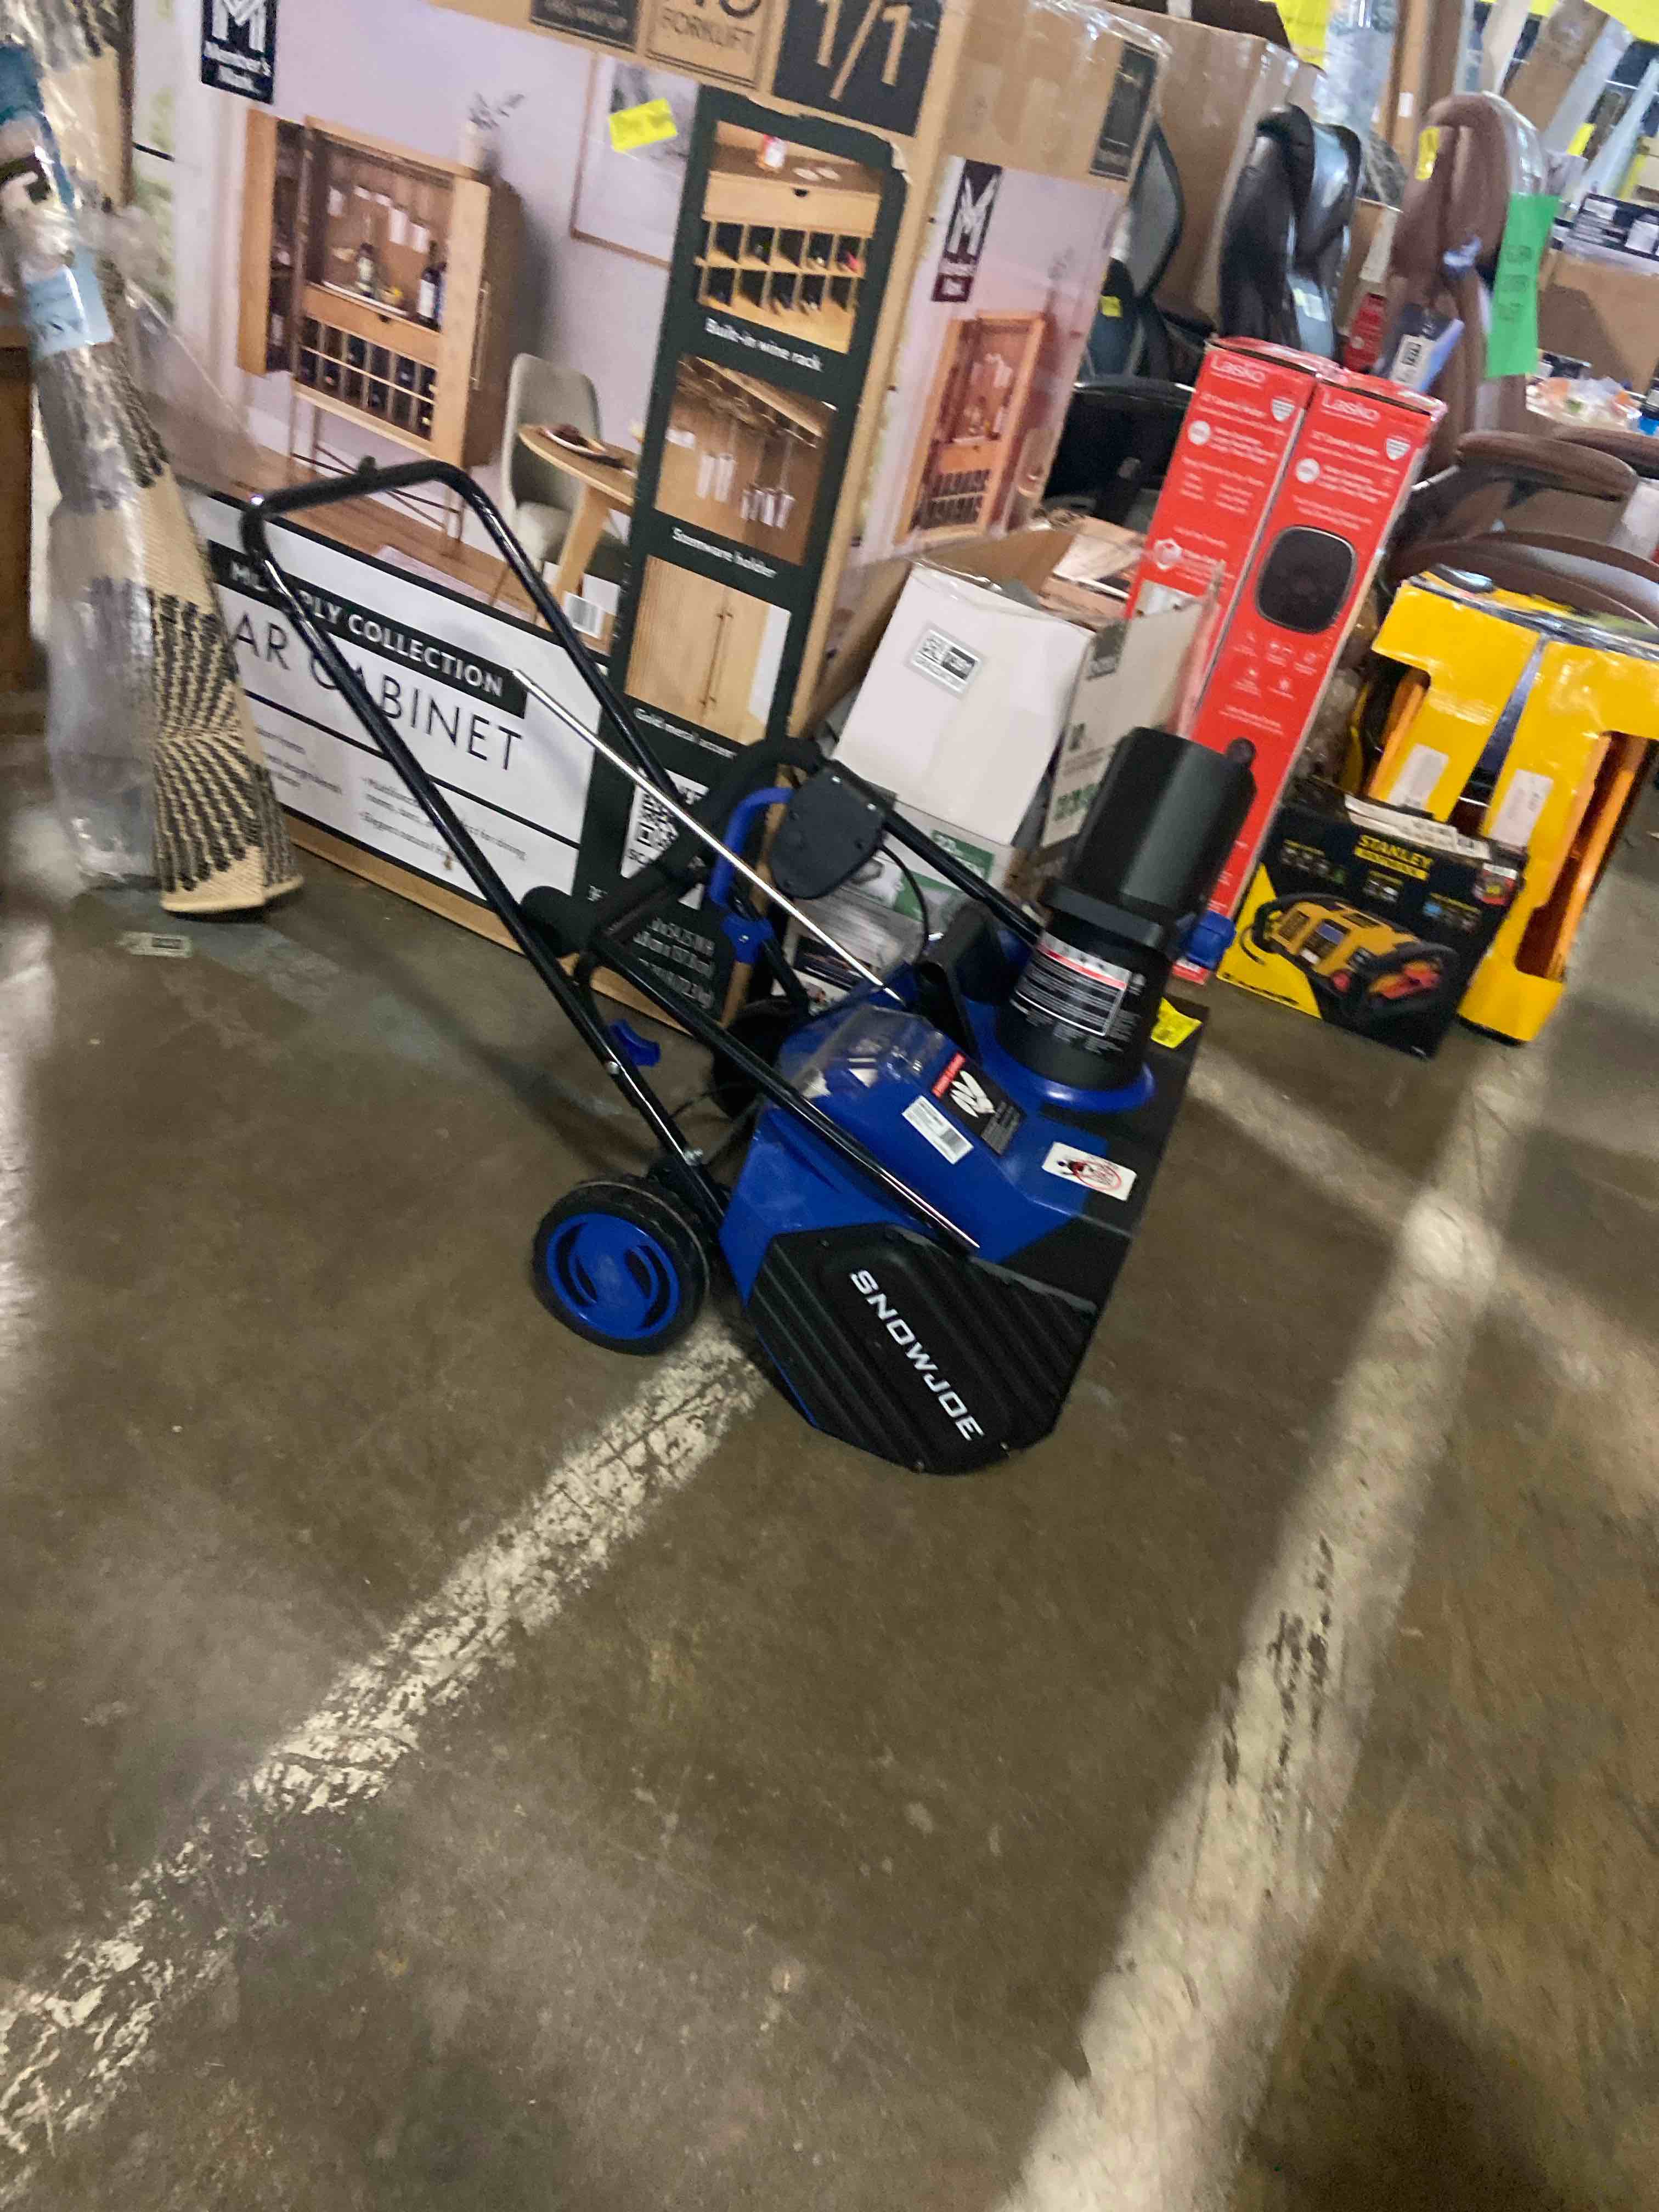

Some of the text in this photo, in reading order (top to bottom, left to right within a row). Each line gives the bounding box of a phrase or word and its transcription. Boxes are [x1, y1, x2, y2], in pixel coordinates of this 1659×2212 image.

[816, 0, 912, 101] 1/1
[759, 338, 791, 361] wine
[792, 351, 825, 373] rack
[1210, 355, 1266, 383] Lasko
[1322, 392, 1381, 422] Lasko
[348, 614, 503, 698] COLLECTION
[231, 610, 523, 771] AR CBINET
[1358, 833, 1435, 870] STANLEY
[850, 1269, 985, 1441] SNOWJOE
